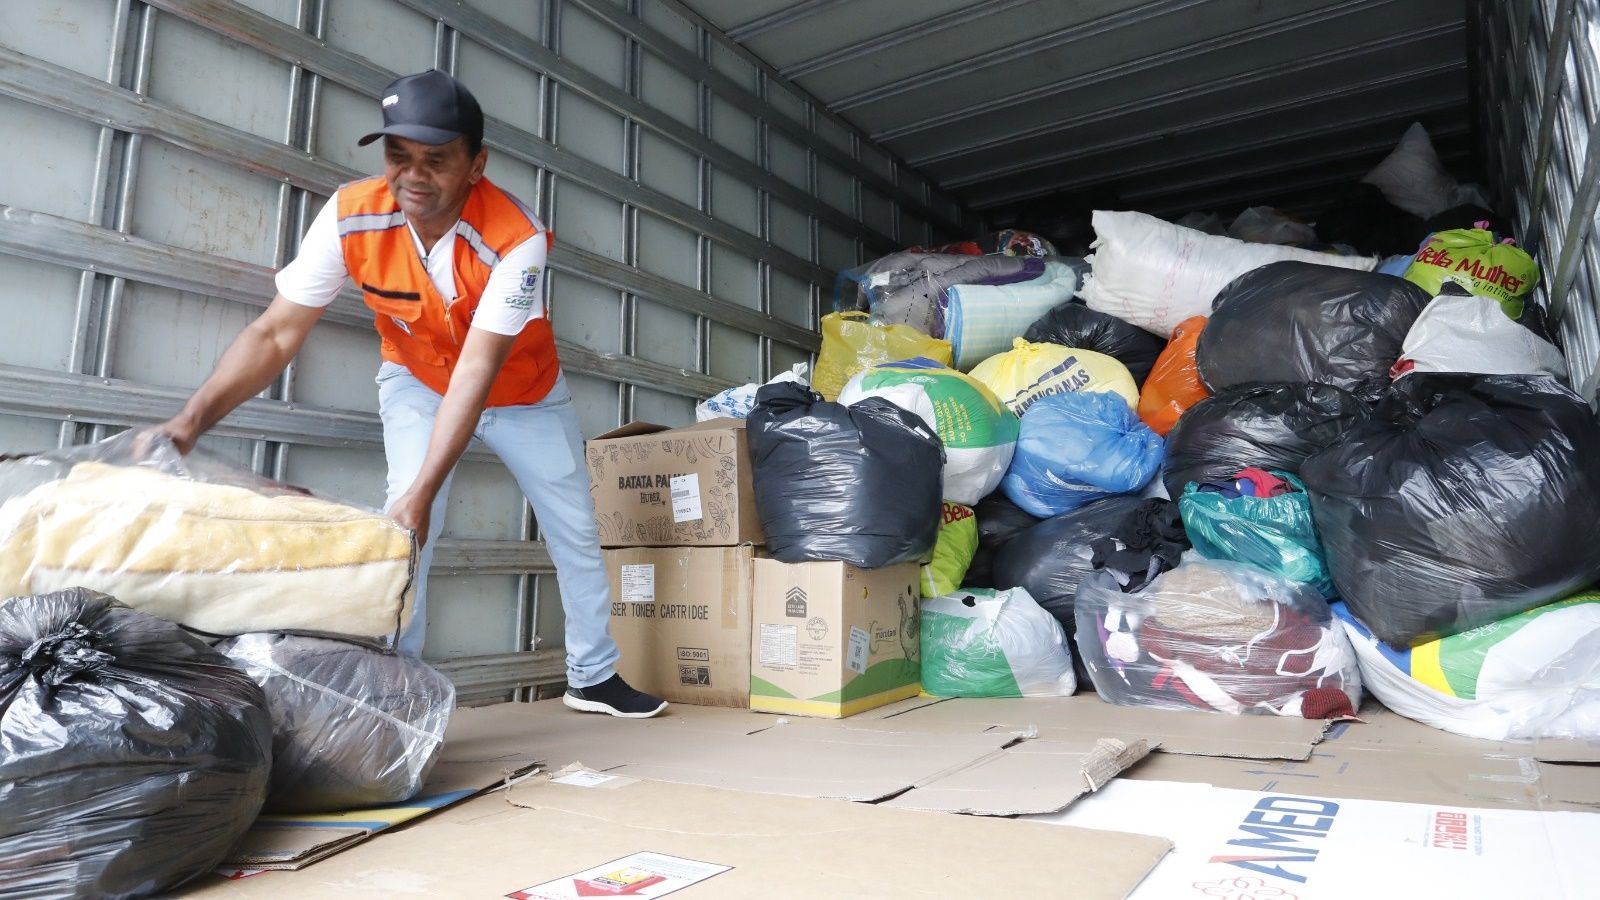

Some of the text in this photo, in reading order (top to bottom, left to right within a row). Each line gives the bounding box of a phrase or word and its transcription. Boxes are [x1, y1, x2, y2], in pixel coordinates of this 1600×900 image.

[1454, 257, 1524, 293] Mulher
[618, 475, 653, 489] BATATA
[611, 602, 709, 620] SER TONER CARTRIDGE
